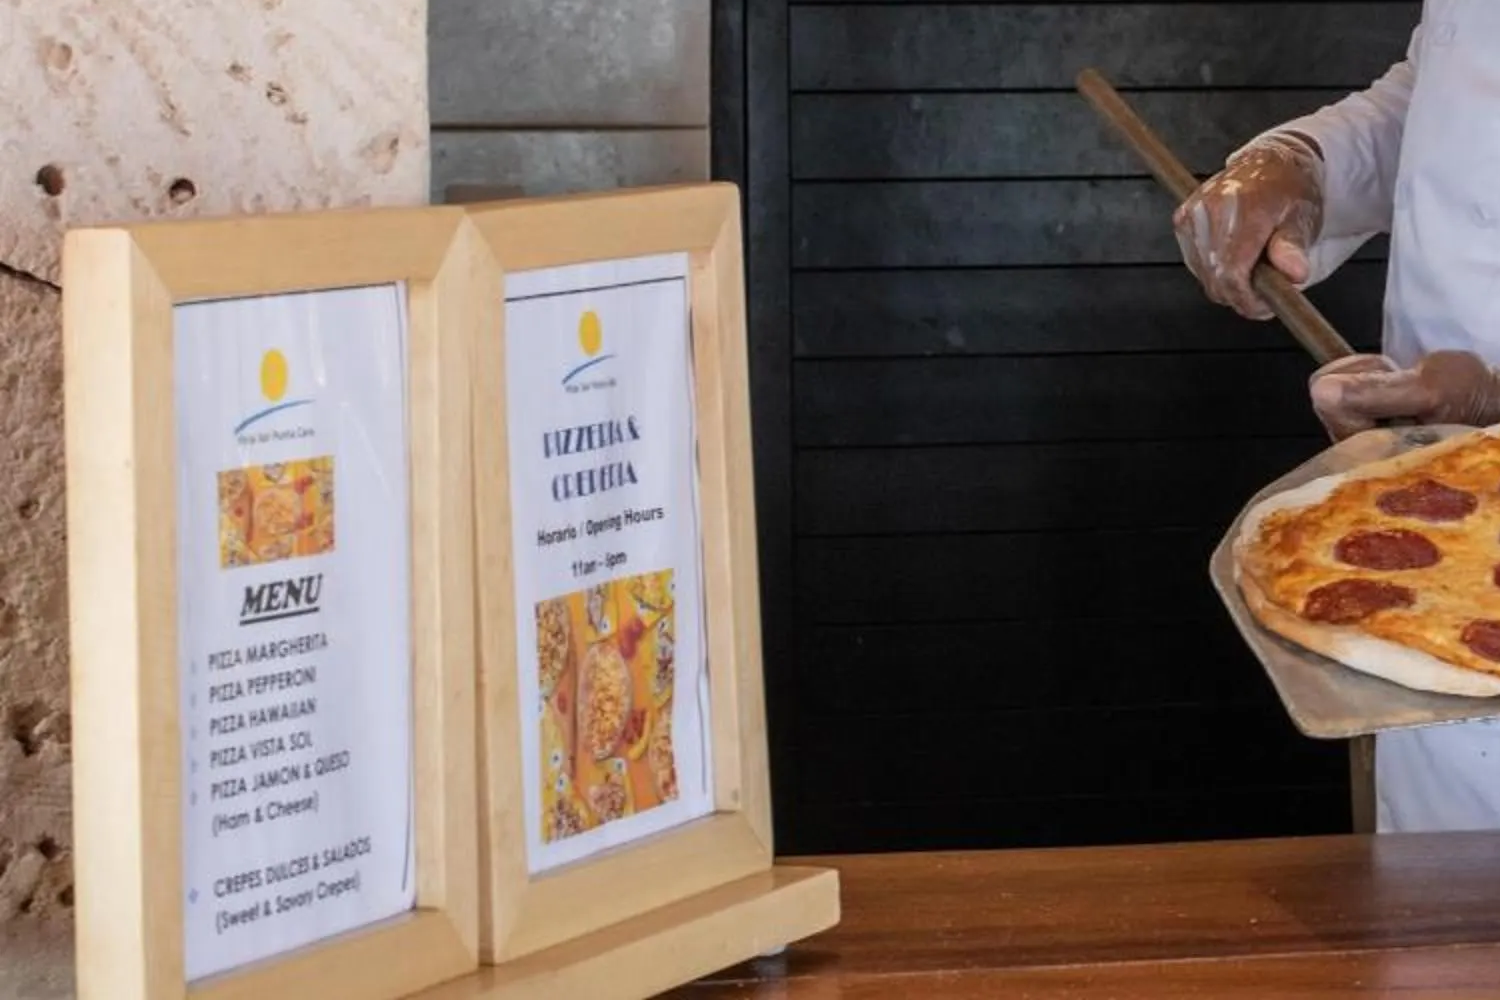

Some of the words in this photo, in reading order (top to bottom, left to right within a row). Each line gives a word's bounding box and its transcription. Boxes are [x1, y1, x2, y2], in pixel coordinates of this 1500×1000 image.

[537, 525, 577, 547] Horario
[586, 514, 622, 537] Opening
[623, 507, 665, 526] Hours
[240, 573, 323, 618] MENU
[208, 649, 243, 671] PIZZA
[246, 632, 329, 665] MARGHERITA
[209, 681, 244, 704] PIZZA
[247, 666, 317, 696] PEPPERONI
[210, 713, 246, 737] PIZZA
[210, 745, 247, 769] PIZZA
[250, 736, 286, 759] VISTA
[289, 730, 313, 751] SOL
[211, 777, 247, 801] PIZZA
[303, 763, 312, 780] &
[314, 750, 351, 777] QUESO
[211, 812, 251, 838] (Ham
[254, 806, 264, 823] &
[266, 790, 320, 821] Cheese)
[213, 869, 263, 898] CREPES
[265, 856, 310, 885] DULCES
[312, 853, 320, 871] &
[215, 902, 260, 935] (Sweet
[263, 899, 272, 916] &
[275, 889, 314, 914] Savory
